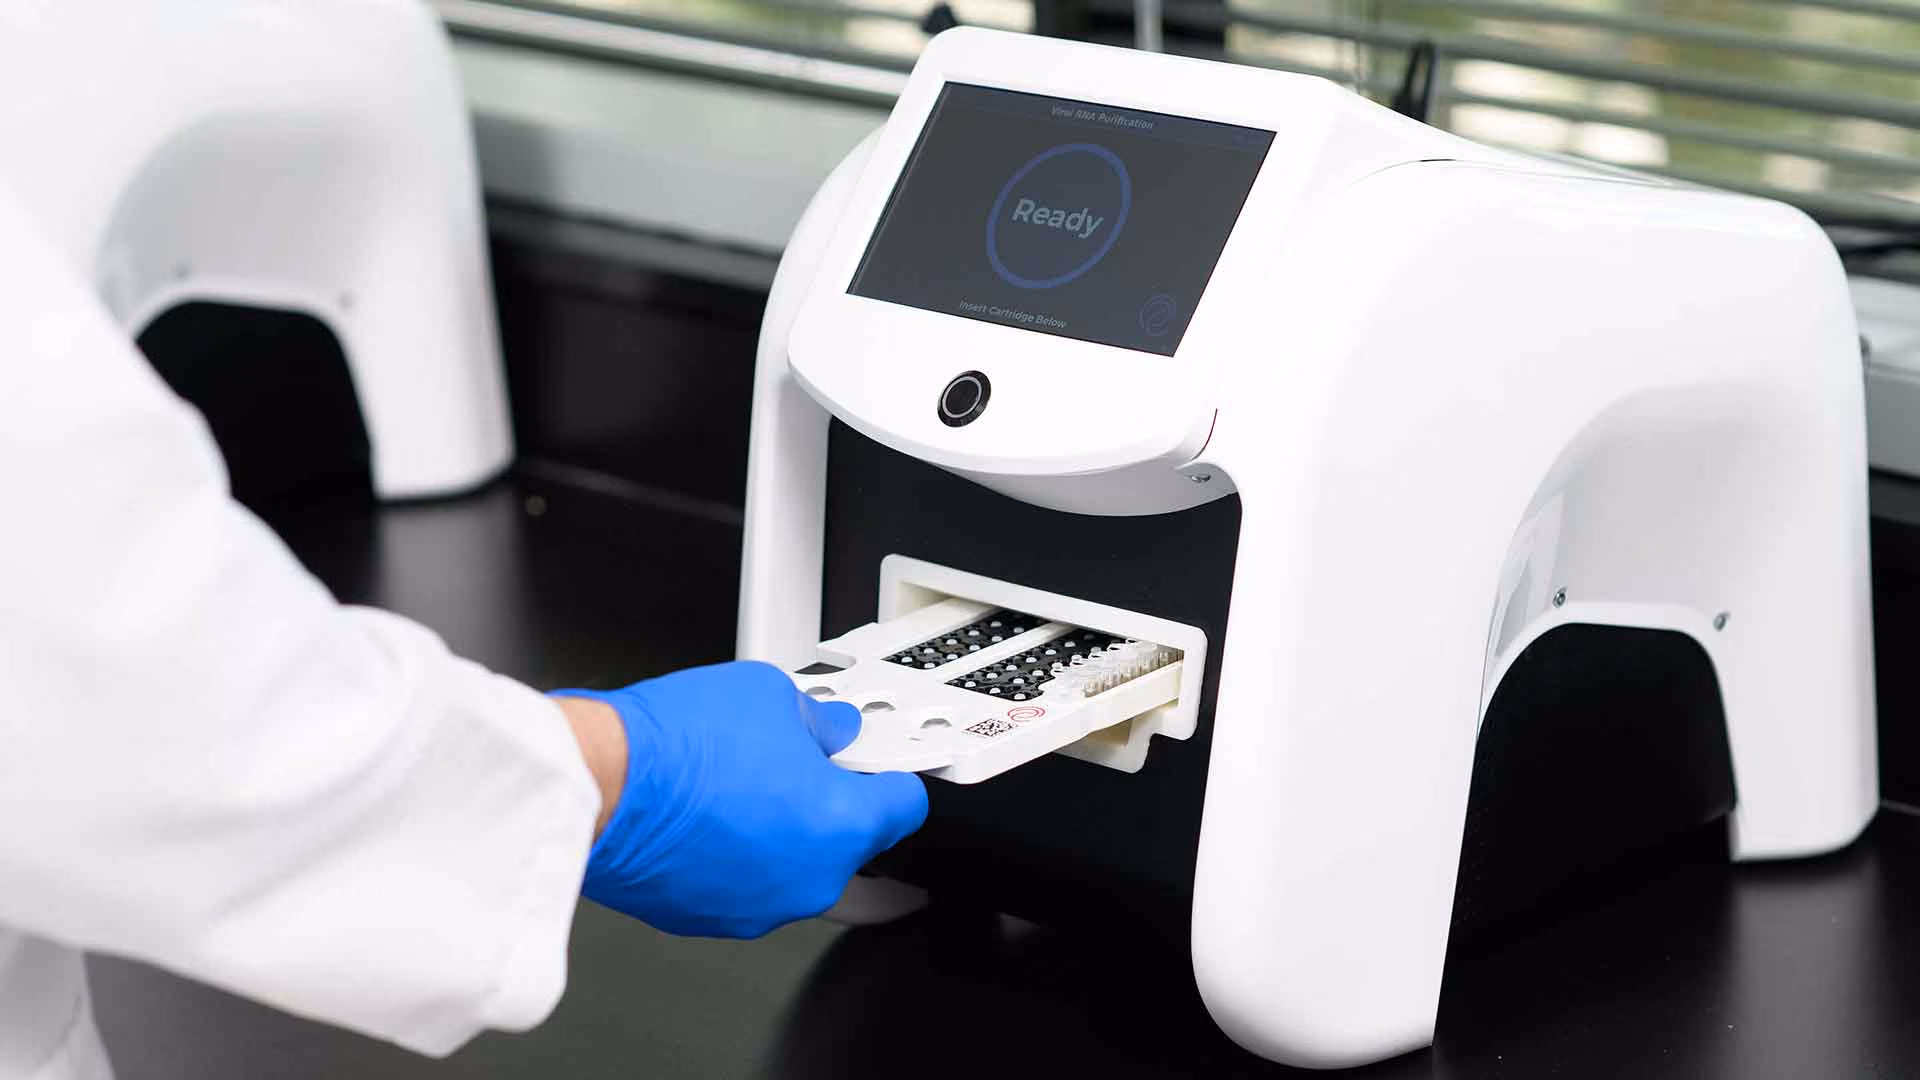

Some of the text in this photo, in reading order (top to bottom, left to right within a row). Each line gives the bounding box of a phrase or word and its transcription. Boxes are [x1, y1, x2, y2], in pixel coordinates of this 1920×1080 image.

[1075, 110, 1096, 121] RNA
[1099, 112, 1153, 129] Purification
[1012, 198, 1104, 239] Ready
[959, 300, 1067, 329] Insert Cartridge Below
